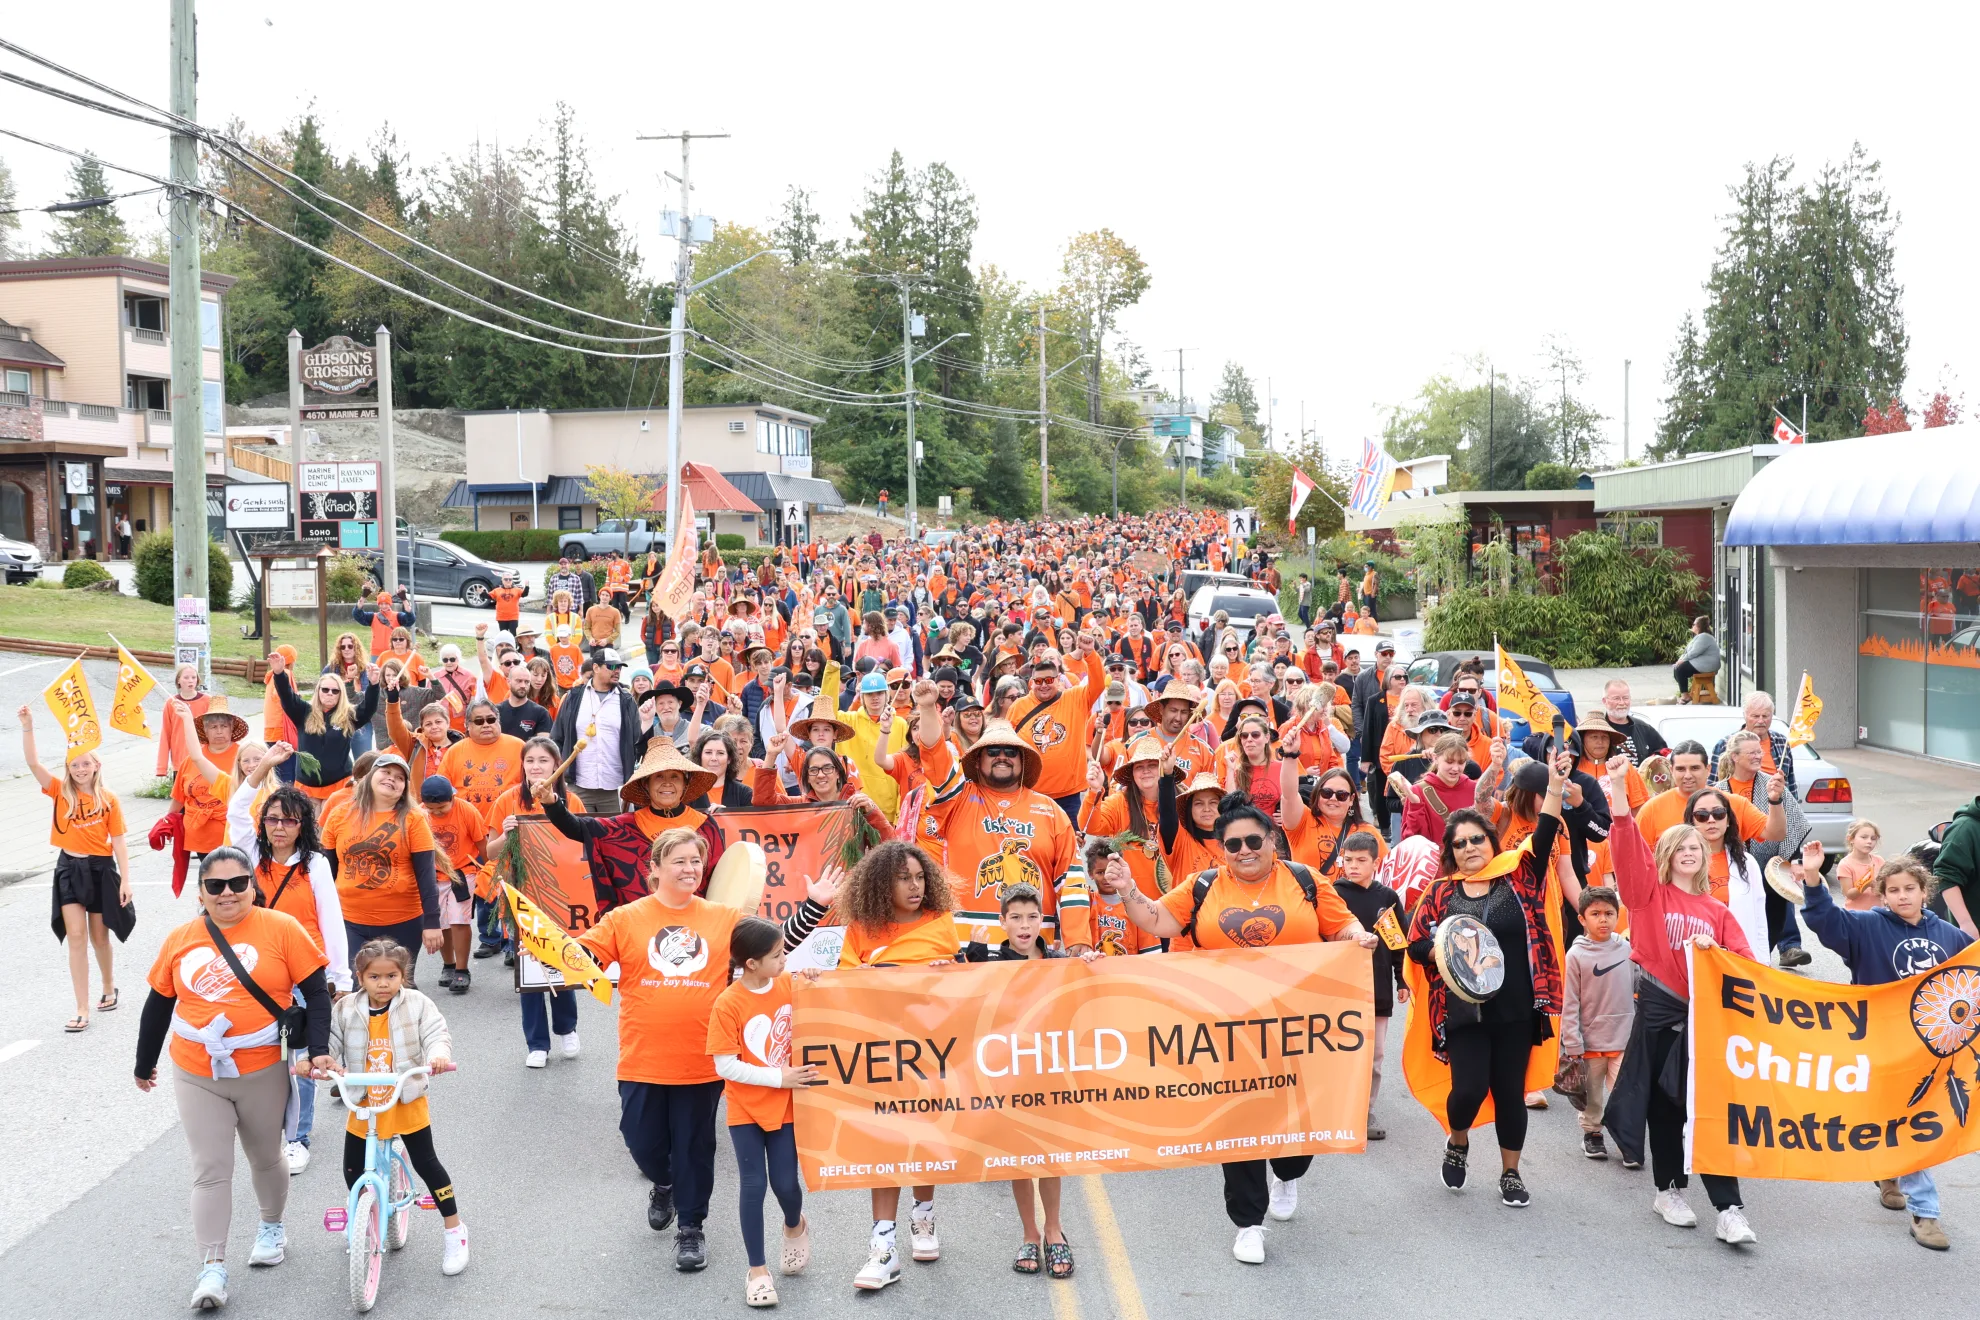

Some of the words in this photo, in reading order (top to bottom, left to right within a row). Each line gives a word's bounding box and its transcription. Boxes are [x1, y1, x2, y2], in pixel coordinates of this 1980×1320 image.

[304, 351, 372, 366] GIBSON'S
[304, 364, 373, 378] CROSSING
[318, 380, 340, 392] SHOPPING
[306, 412, 326, 420] 4670
[329, 410, 359, 419] MARINE
[268, 498, 286, 506] sushi
[324, 500, 356, 512] knack
[358, 522, 374, 546] T
[739, 829, 799, 859] Day
[765, 861, 786, 887] &
[1220, 908, 1244, 924] Every
[1228, 928, 1250, 948] Matte
[816, 946, 842, 954] SAFE
[640, 979, 661, 988] Every
[682, 979, 710, 988] Matters
[1722, 974, 1868, 1040] Every
[802, 1036, 958, 1086] EVERY
[976, 1028, 1128, 1078] CHILD
[1148, 1010, 1364, 1067] MATTERS
[1726, 1034, 1872, 1092] Child
[874, 1098, 965, 1115] NATIONAL
[970, 1094, 1006, 1112] DAY
[1012, 1092, 1045, 1108] FOR
[1050, 1088, 1108, 1104] TRUTH
[1113, 1086, 1150, 1101] AND
[1155, 1073, 1297, 1100] RECONCILIATION
[1728, 1103, 1944, 1152] Matters
[1157, 1143, 1202, 1157] CREATE
[1204, 1142, 1213, 1152] A
[1215, 1136, 1258, 1151] BETTER
[1260, 1132, 1306, 1146] FUTURE
[1309, 1130, 1332, 1142] FOR
[1335, 1129, 1356, 1140] ALL
[984, 1155, 1016, 1168] CARE
[1020, 1154, 1045, 1166] FOR
[1048, 1153, 1072, 1164] THE
[1075, 1148, 1130, 1162] PRESENT
[819, 1164, 873, 1177] REFLECT
[876, 1163, 895, 1174] ON
[898, 1162, 922, 1174] THE
[926, 1160, 958, 1172] PAST
